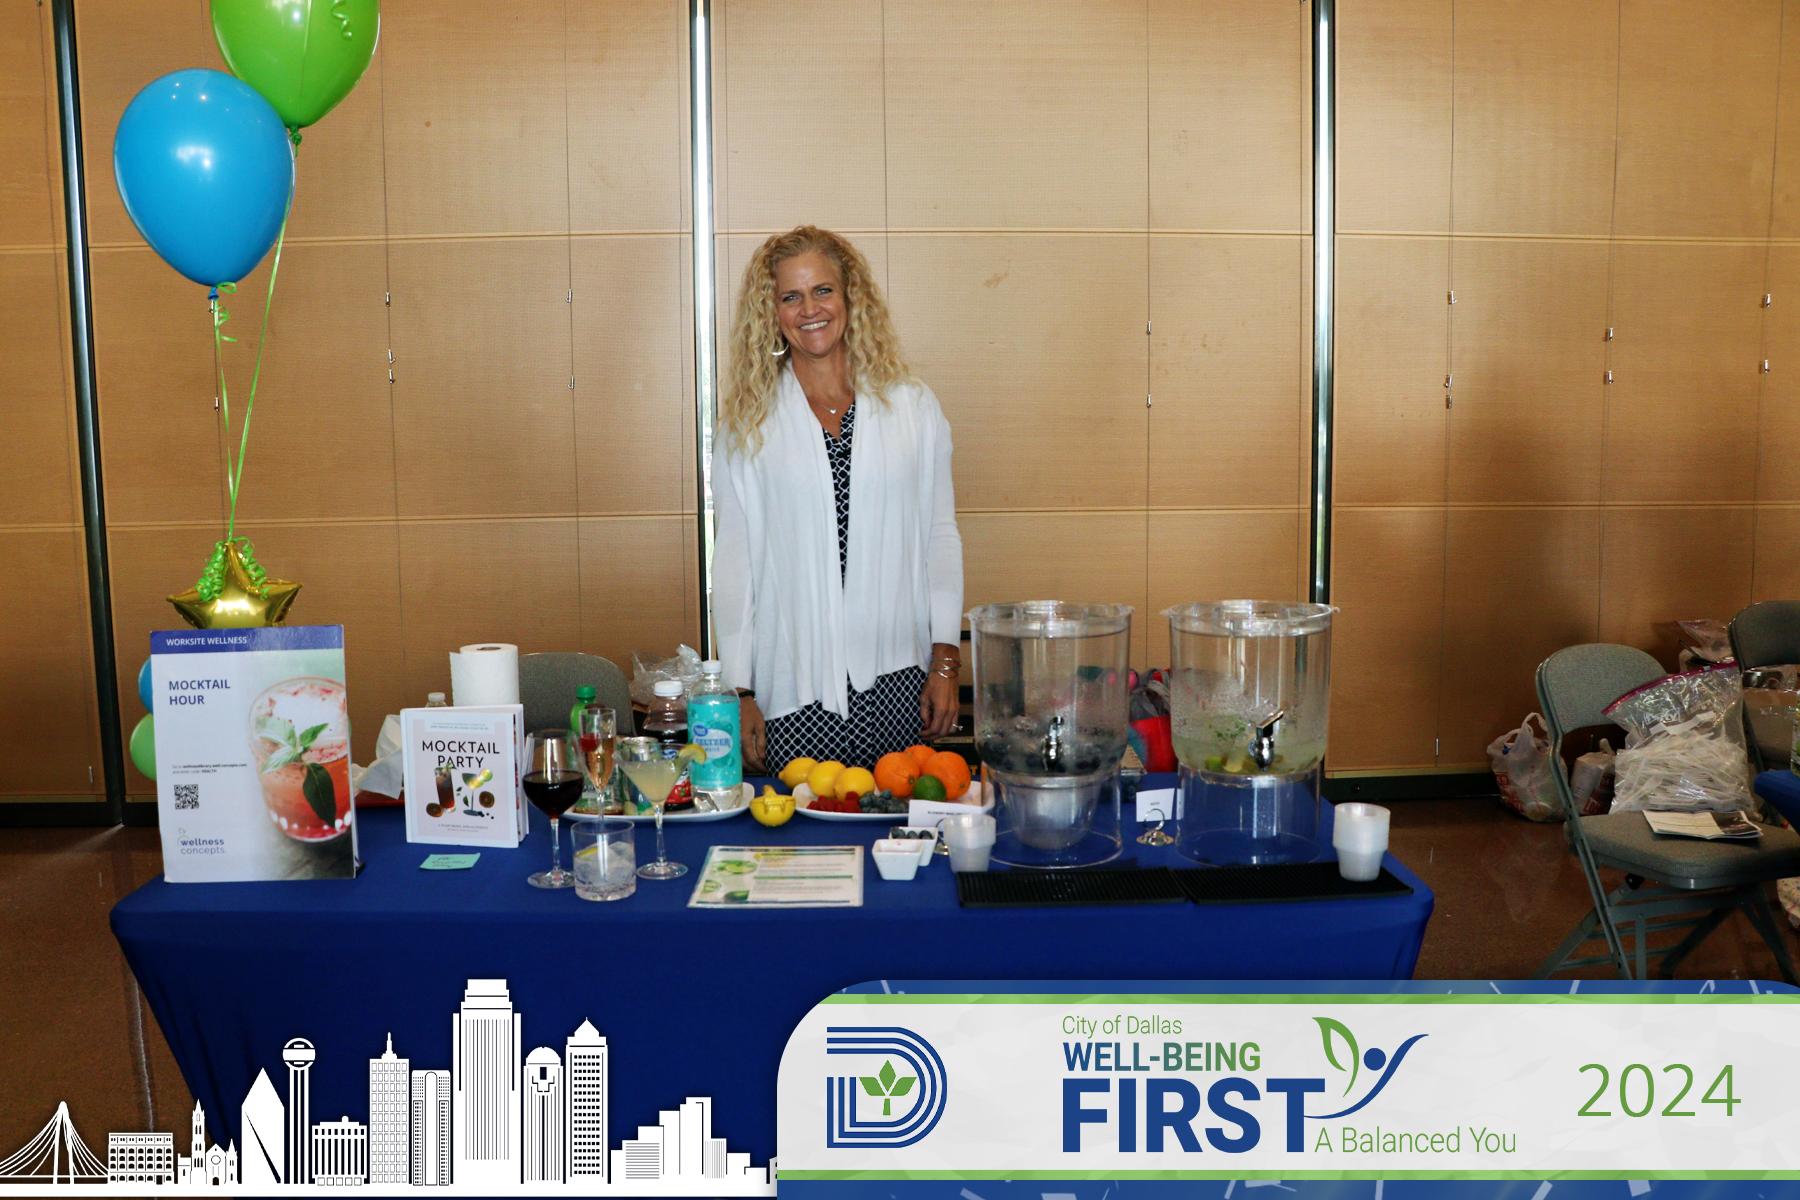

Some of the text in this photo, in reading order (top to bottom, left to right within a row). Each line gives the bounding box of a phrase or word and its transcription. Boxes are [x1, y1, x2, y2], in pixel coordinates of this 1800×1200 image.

[166, 636, 247, 646] WORKSITE WELLNESS
[169, 680, 230, 690] MOCKTAIL
[169, 695, 205, 705] HOUR
[422, 740, 500, 754] MOCKTAIL
[438, 755, 484, 769] PARTY
[180, 838, 224, 846] wellness
[180, 847, 225, 855] concepts
